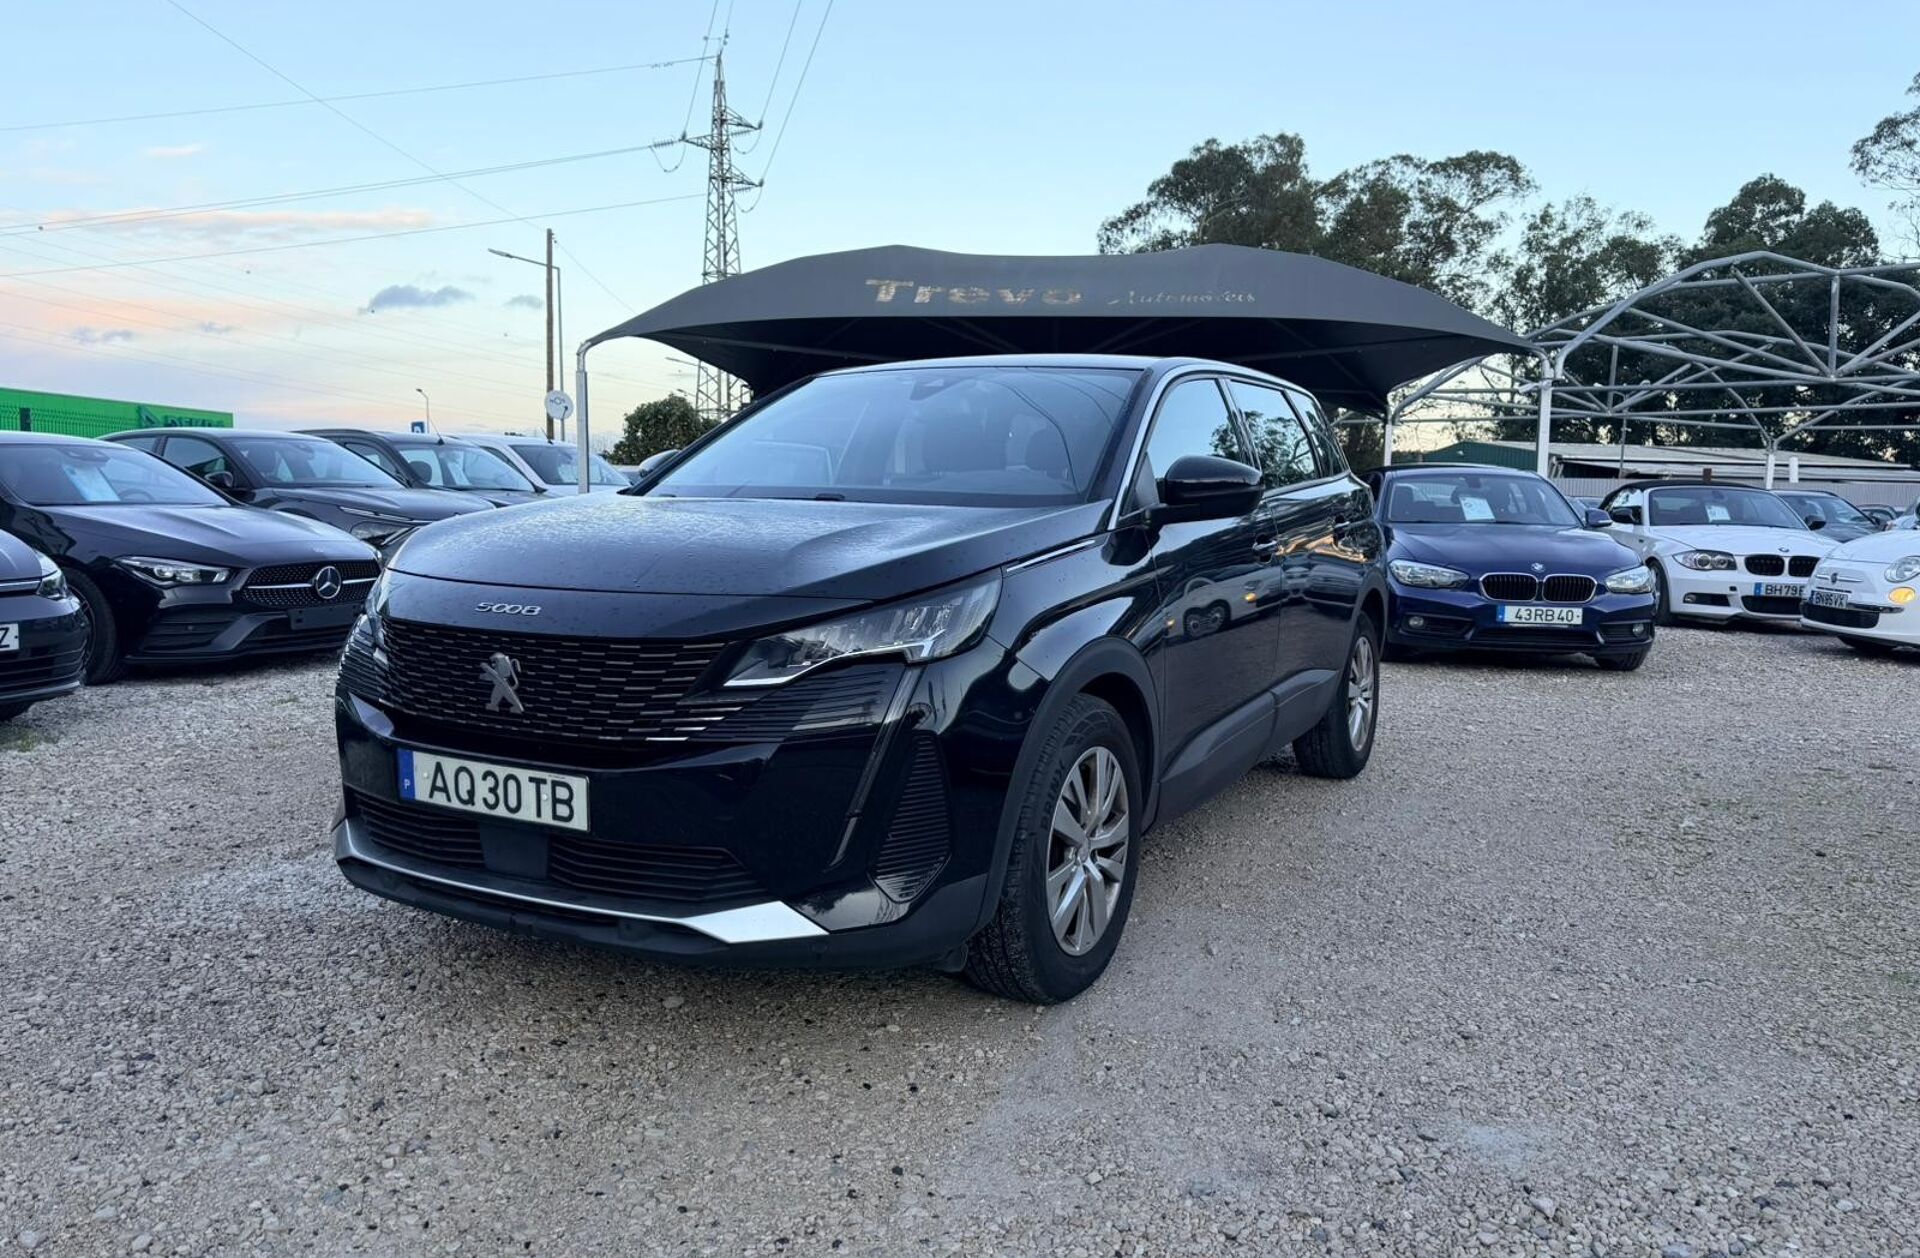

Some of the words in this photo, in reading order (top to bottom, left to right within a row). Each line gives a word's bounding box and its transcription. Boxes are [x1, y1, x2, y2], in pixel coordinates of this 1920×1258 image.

[865, 279, 1083, 304] Trevo
[474, 602, 542, 616] 5008
[1514, 608, 1575, 623] 43RB40
[428, 761, 576, 823] AQ30TB
